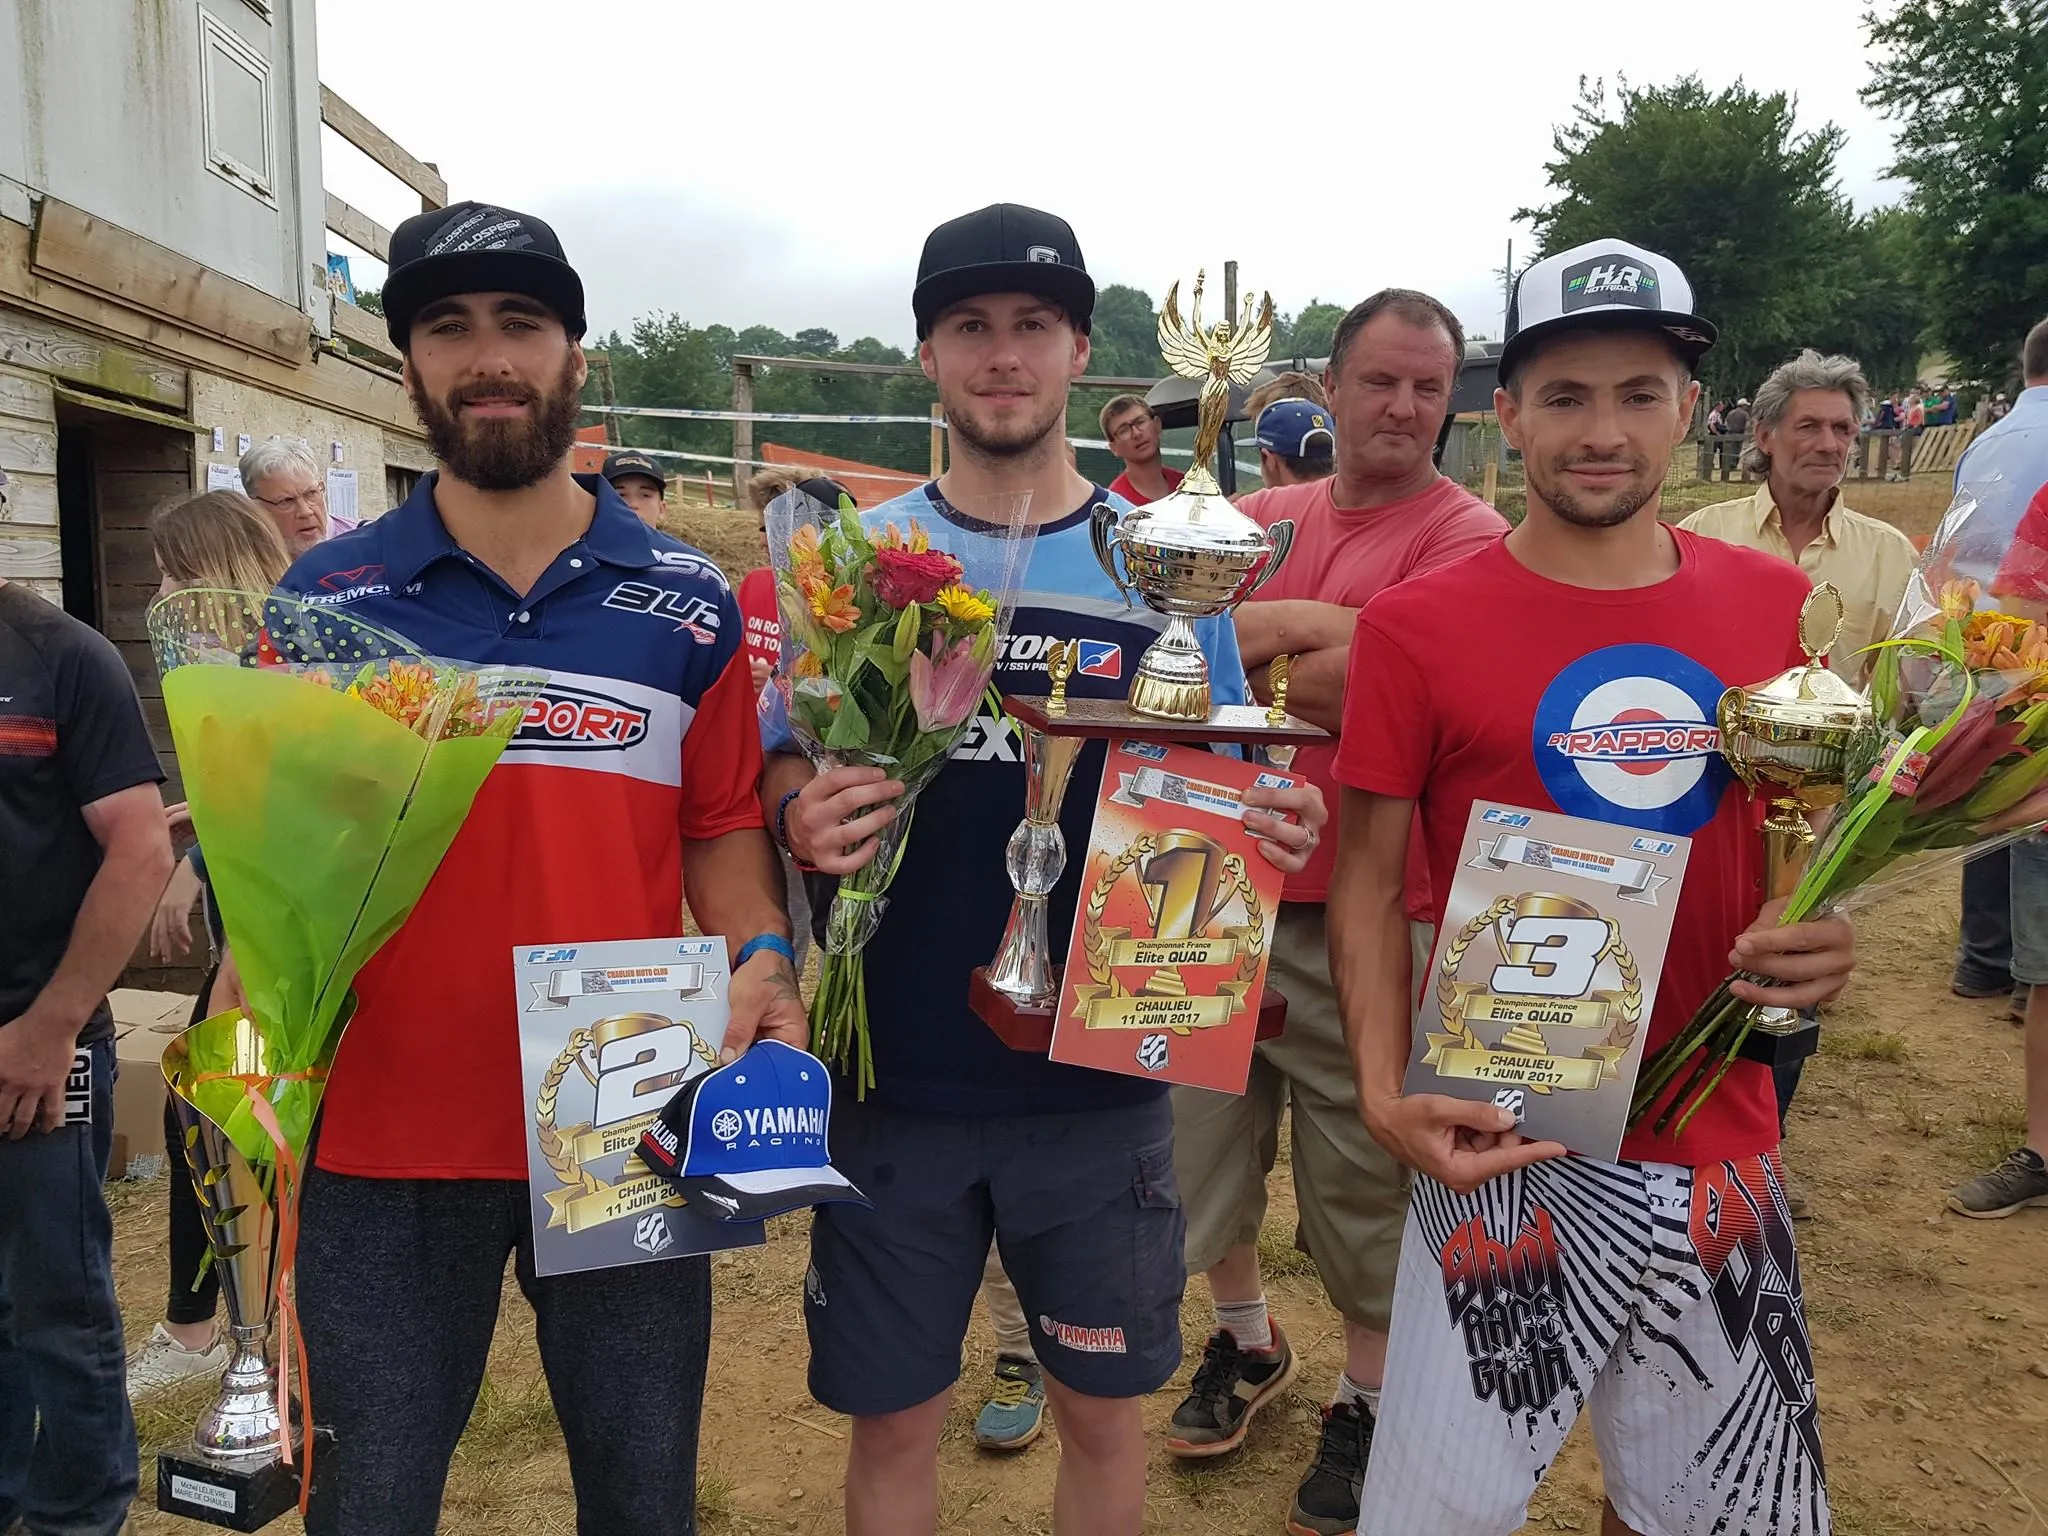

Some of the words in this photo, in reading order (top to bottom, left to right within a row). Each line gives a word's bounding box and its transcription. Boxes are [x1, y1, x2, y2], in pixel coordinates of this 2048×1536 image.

[301, 582, 422, 608] TREMCM
[748, 616, 763, 632] ON
[763, 620, 780, 635] RO
[1009, 662, 1031, 671] SSV
[950, 716, 1026, 762] EX
[1547, 732, 1572, 747] BY
[1566, 729, 1720, 755] RAPPORT
[1186, 781, 1212, 795] CHAULIEU
[1212, 786, 1228, 799] MOTO
[1551, 846, 1579, 859] CHAULIEU
[1580, 852, 1598, 863] MOTO
[1599, 855, 1616, 866] CLUB
[1552, 857, 1572, 866] CIRCUIT
[1143, 846, 1208, 938] 1
[1136, 941, 1186, 950] Championnat
[1186, 941, 1211, 950] France
[1134, 951, 1164, 963] Elite
[1168, 951, 1207, 963] QUAD
[1490, 915, 1611, 997] 3
[607, 969, 635, 979] CHAULIEU
[636, 968, 653, 977] MOTO
[653, 967, 669, 976] CLUB
[610, 978, 630, 986] CIRCUIT
[1135, 1000, 1192, 1012] CHAULIEU
[1493, 998, 1547, 1010] Championnat
[1549, 1001, 1578, 1011] France
[1121, 1014, 1136, 1025] 11
[1139, 1014, 1167, 1025] JUIN
[1171, 1013, 1200, 1024] 2017
[1490, 1007, 1524, 1021] Elite
[1527, 1010, 1573, 1024] QUAD
[1489, 1055, 1555, 1070] CHAULIEU
[593, 1023, 693, 1130] 2
[1474, 1066, 1490, 1077] 11
[1493, 1067, 1525, 1080] JUIN
[1528, 1071, 1563, 1084] 2017
[64, 1053, 91, 1125] LIEU
[744, 1106, 825, 1136] YAMAHA
[603, 1134, 636, 1154] Elite
[649, 1117, 680, 1156] ALUB
[726, 1136, 821, 1151] RACING
[618, 1177, 671, 1200] CHAULI
[606, 1203, 622, 1217] 11
[627, 1191, 657, 1211] JUIN
[660, 1186, 677, 1200] 20
[1053, 1320, 1125, 1346] YAMAHA
[1060, 1339, 1089, 1351] RACING
[1090, 1344, 1125, 1352] FRANCE
[174, 1487, 193, 1497] MAIRE
[194, 1493, 202, 1501] DE
[203, 1495, 233, 1509] CHAULIEU
[180, 1480, 198, 1492] Michel
[198, 1486, 226, 1499] LELIEVRE
